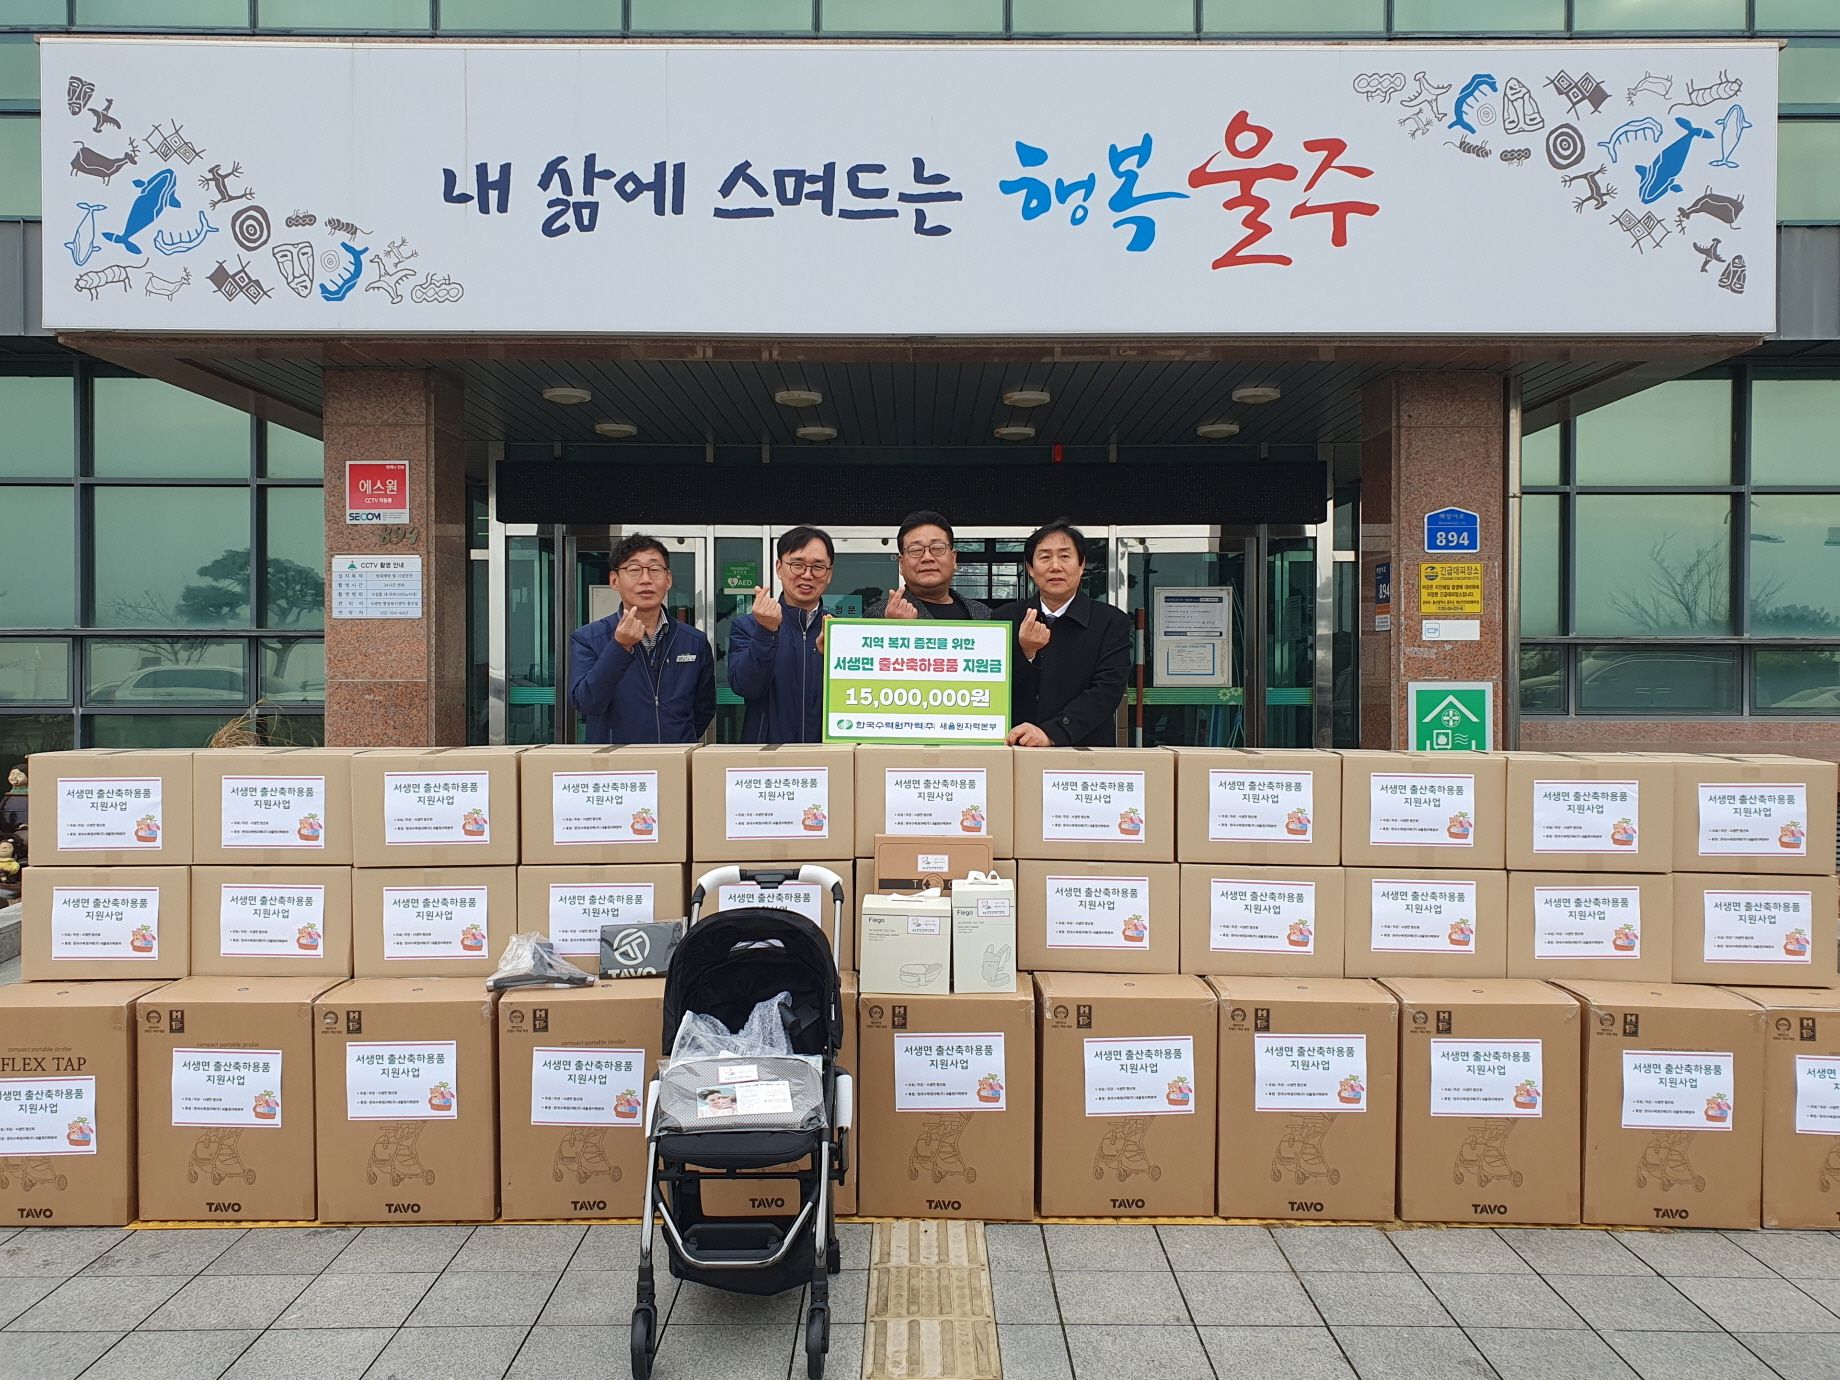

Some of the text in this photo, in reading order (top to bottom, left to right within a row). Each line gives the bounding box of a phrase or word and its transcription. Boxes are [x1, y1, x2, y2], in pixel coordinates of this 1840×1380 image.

[443, 162, 511, 215] 내
[537, 153, 685, 238] 삶에
[713, 157, 963, 236] 스며드는
[359, 480, 398, 494] 에스원
[349, 512, 381, 521] SECOM
[1436, 532, 1469, 546] 894
[1440, 566, 1479, 576] 긴급대피장소
[1379, 583, 1390, 599] 894
[862, 636, 975, 650] 지역 복지 증진을 위한
[834, 657, 1002, 673] 서생면 출산축하용품 지원금
[845, 688, 990, 709] 15,000,000원
[940, 722, 997, 731] 새울원자력본부
[394, 782, 478, 793] 서생면 출산축하용품
[562, 782, 647, 793] 서생면 출산축하용품
[735, 778, 818, 789] 서생면 출산축하용품
[894, 779, 976, 789] 서생면 출산축하용품
[1052, 781, 1134, 792] 서생면 출산축하용품
[1218, 780, 1302, 792] 서생면 출산축하용품
[66, 789, 151, 799] 서생면 출산축하용품
[231, 787, 314, 797] 서생면 출산축하용품
[1380, 784, 1464, 795] 서생면 출산축하용품
[417, 795, 454, 806] 지원사업
[586, 795, 623, 805] 지원사업
[758, 791, 794, 801] 지원사업
[917, 792, 953, 801] 지원사업
[1075, 794, 1111, 804] 지원사업
[1242, 794, 1278, 804] 지원사업
[1543, 792, 1628, 802] 서생면 출산축하용품
[1708, 795, 1795, 804] 서생면 출산축하용품
[90, 802, 127, 811] 지원사업
[254, 800, 290, 809] 지원사업
[1404, 797, 1440, 807] 지원사업
[1567, 804, 1604, 814] 지원사업
[1733, 807, 1771, 817] 지원사업
[1055, 887, 1138, 898] 서생면 출산축하용품
[1220, 890, 1304, 903] 서생면 출산축하용품
[1381, 891, 1465, 902] 서생면 출산축하용품
[62, 898, 148, 908] 서생면 출산축하용품
[230, 896, 314, 906] 서생면 출산축하용품
[392, 898, 477, 908] 서생면 출산축하용품
[559, 895, 643, 905] 서생면 출산축하용품
[728, 893, 811, 903] 서생면 출산축하용품
[1544, 898, 1629, 908] 서생면 출산축하용품
[1078, 900, 1114, 910] 지원사업
[1244, 904, 1280, 915] 지원사업
[1405, 904, 1442, 914] 지원사업
[1714, 902, 1800, 912] 서생면 출산축하용품
[86, 911, 123, 921] 지원사업
[253, 908, 289, 919] 지원사업
[416, 910, 452, 920] 지원사업
[582, 908, 619, 917] 지원사업
[1568, 910, 1605, 920] 지원사업
[1738, 915, 1776, 924] 지원사업
[904, 1045, 993, 1056] 서생면 출산축하용품
[1094, 1048, 1182, 1061] 서생면 출산축하용품
[1265, 1046, 1355, 1057] 서생면 출산축하용품
[356, 1053, 445, 1065] 서생면 출산축하용품
[1441, 1051, 1531, 1062] 서생면 출산축하용품
[1, 1057, 87, 1071] FLEX TAP
[182, 1061, 270, 1072] 서생면 출산축하용품
[543, 1060, 633, 1072] 서생면 출산축하용품
[929, 1059, 968, 1070] 지원사업
[1120, 1063, 1158, 1074] 지원사업
[1291, 1060, 1329, 1070] 지원사업
[1633, 1063, 1722, 1075] 서생면 출산축하용품
[381, 1067, 419, 1078] 지원사업
[1467, 1065, 1506, 1076] 지원사업
[1807, 1068, 1836, 1079] 서생면
[206, 1075, 245, 1086] 지원사업
[568, 1074, 607, 1085] 지원사업
[1658, 1077, 1697, 1088] 지원사업
[0, 1088, 84, 1101] 생면 출산축하용품
[18, 1103, 57, 1114] 지원사업
[206, 1203, 241, 1212] TAVO
[571, 1201, 606, 1210] TAVO
[750, 1198, 784, 1208] TAVO
[926, 1200, 961, 1210] TAVO
[1110, 1199, 1145, 1208] TAVO
[1288, 1202, 1323, 1212] TAVO
[18, 1208, 53, 1218] TAVO
[385, 1204, 421, 1213] TAVO
[1472, 1204, 1507, 1215] TAVO
[1654, 1208, 1688, 1219] TAVO
